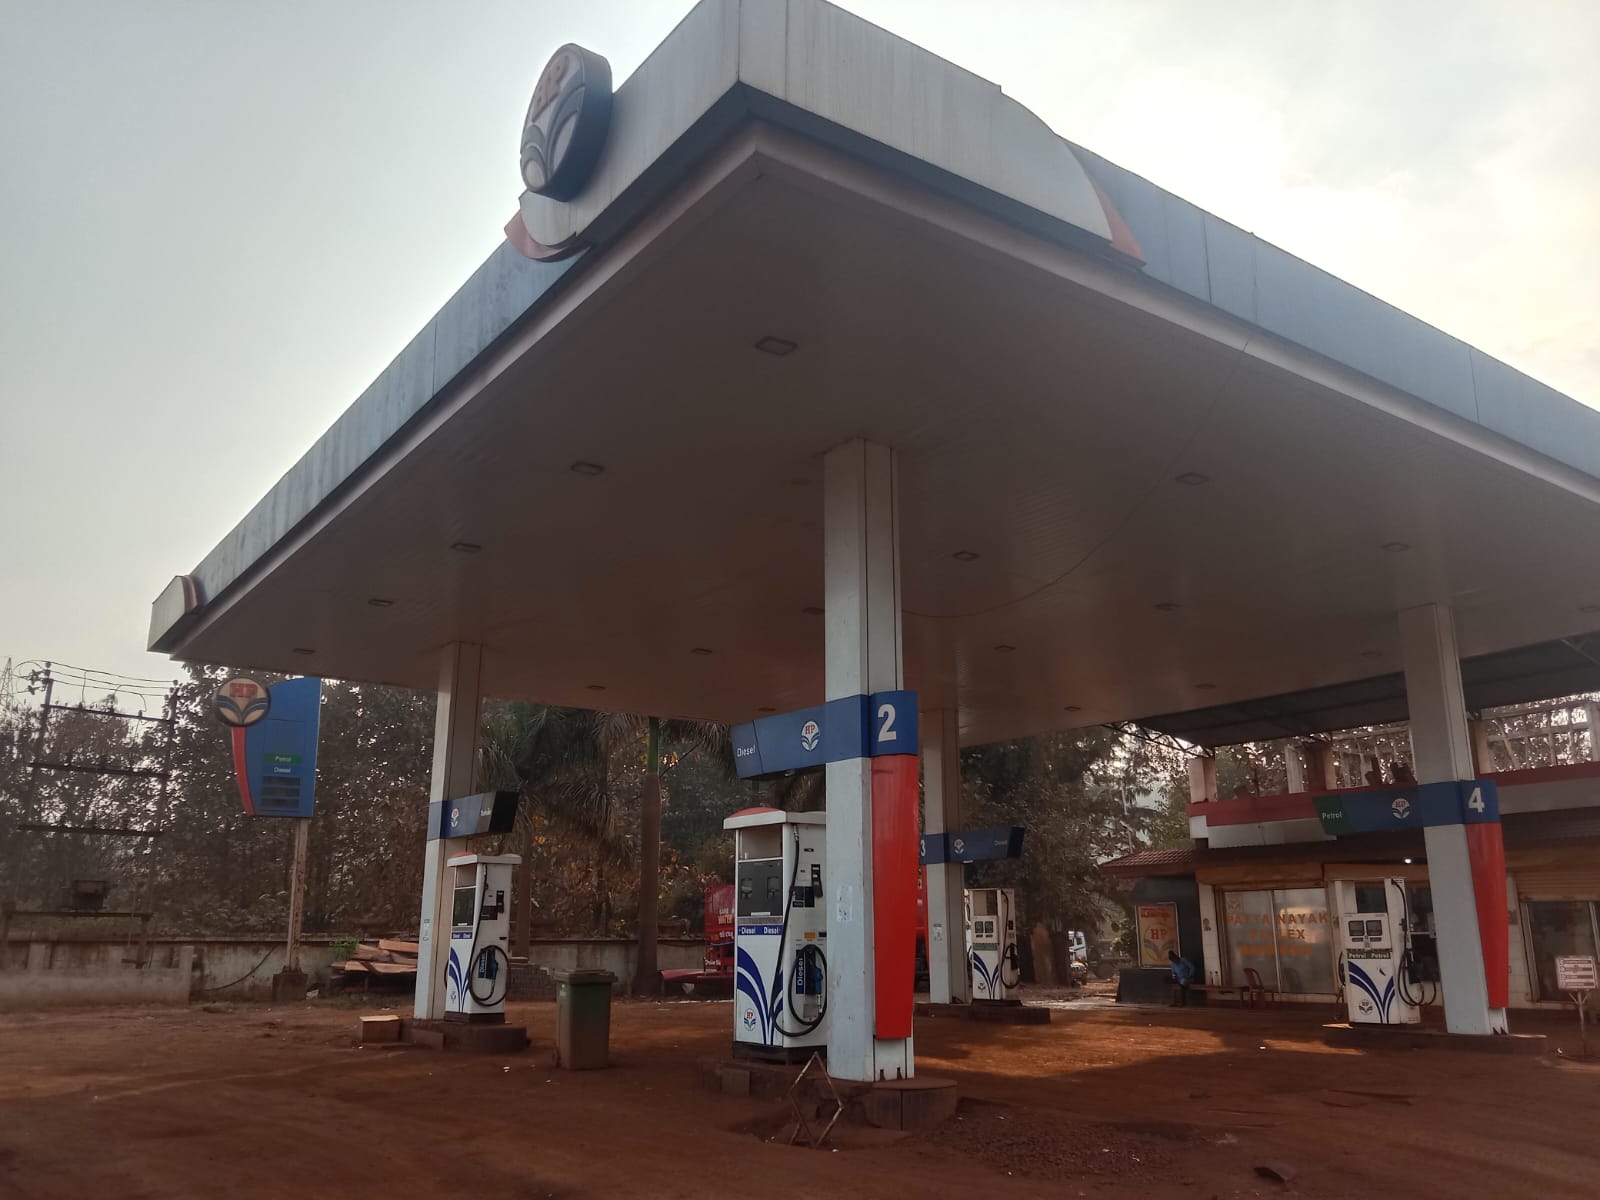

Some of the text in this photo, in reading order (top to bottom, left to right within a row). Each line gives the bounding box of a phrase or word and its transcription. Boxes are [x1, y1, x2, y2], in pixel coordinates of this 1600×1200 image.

[877, 703, 897, 742] 2
[804, 724, 816, 735] HP
[736, 745, 757, 758] Diesel
[1467, 786, 1486, 813] 4
[1321, 811, 1343, 820] Petrol
[741, 926, 779, 935] Diesel Diesel
